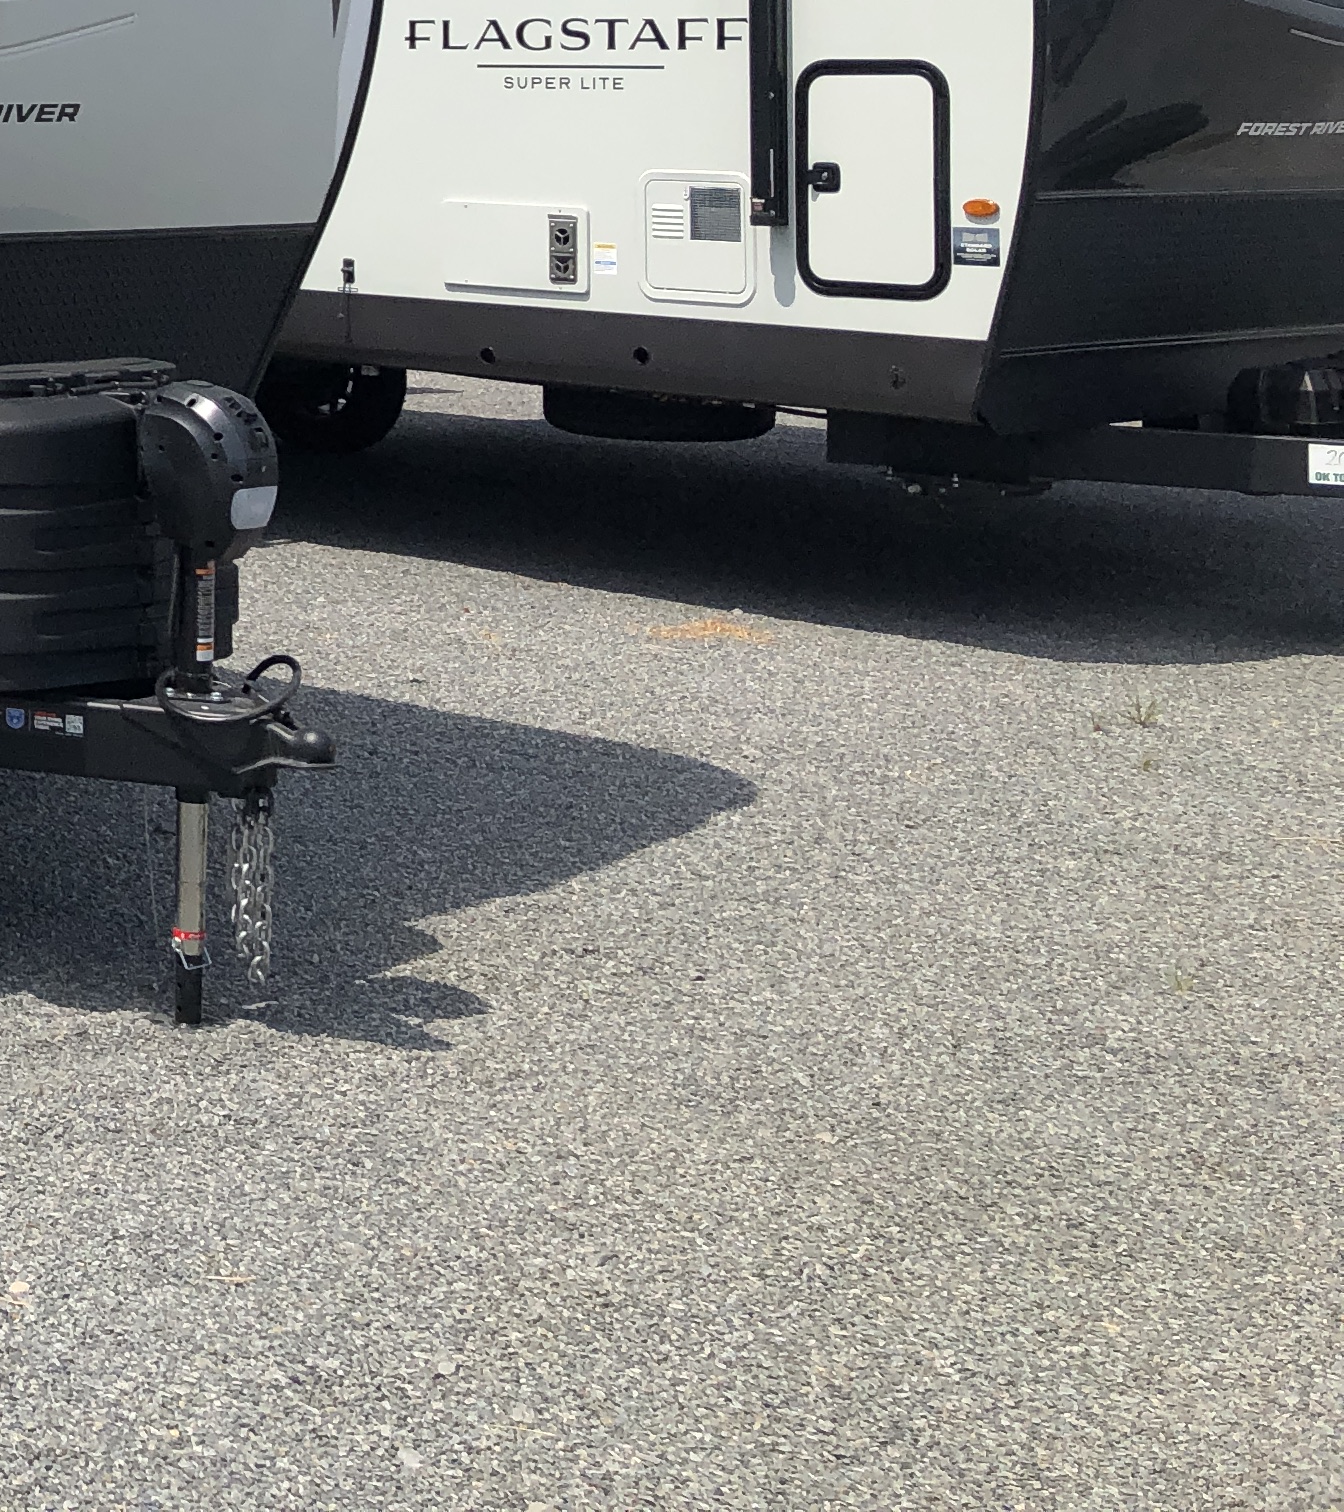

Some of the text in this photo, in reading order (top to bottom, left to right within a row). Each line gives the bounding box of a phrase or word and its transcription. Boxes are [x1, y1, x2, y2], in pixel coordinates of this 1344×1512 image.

[404, 18, 748, 51] FLAGSTAFF
[503, 76, 625, 90] SUPER LITE
[1237, 122, 1310, 136] FOREST
[1315, 471, 1330, 482] OK
